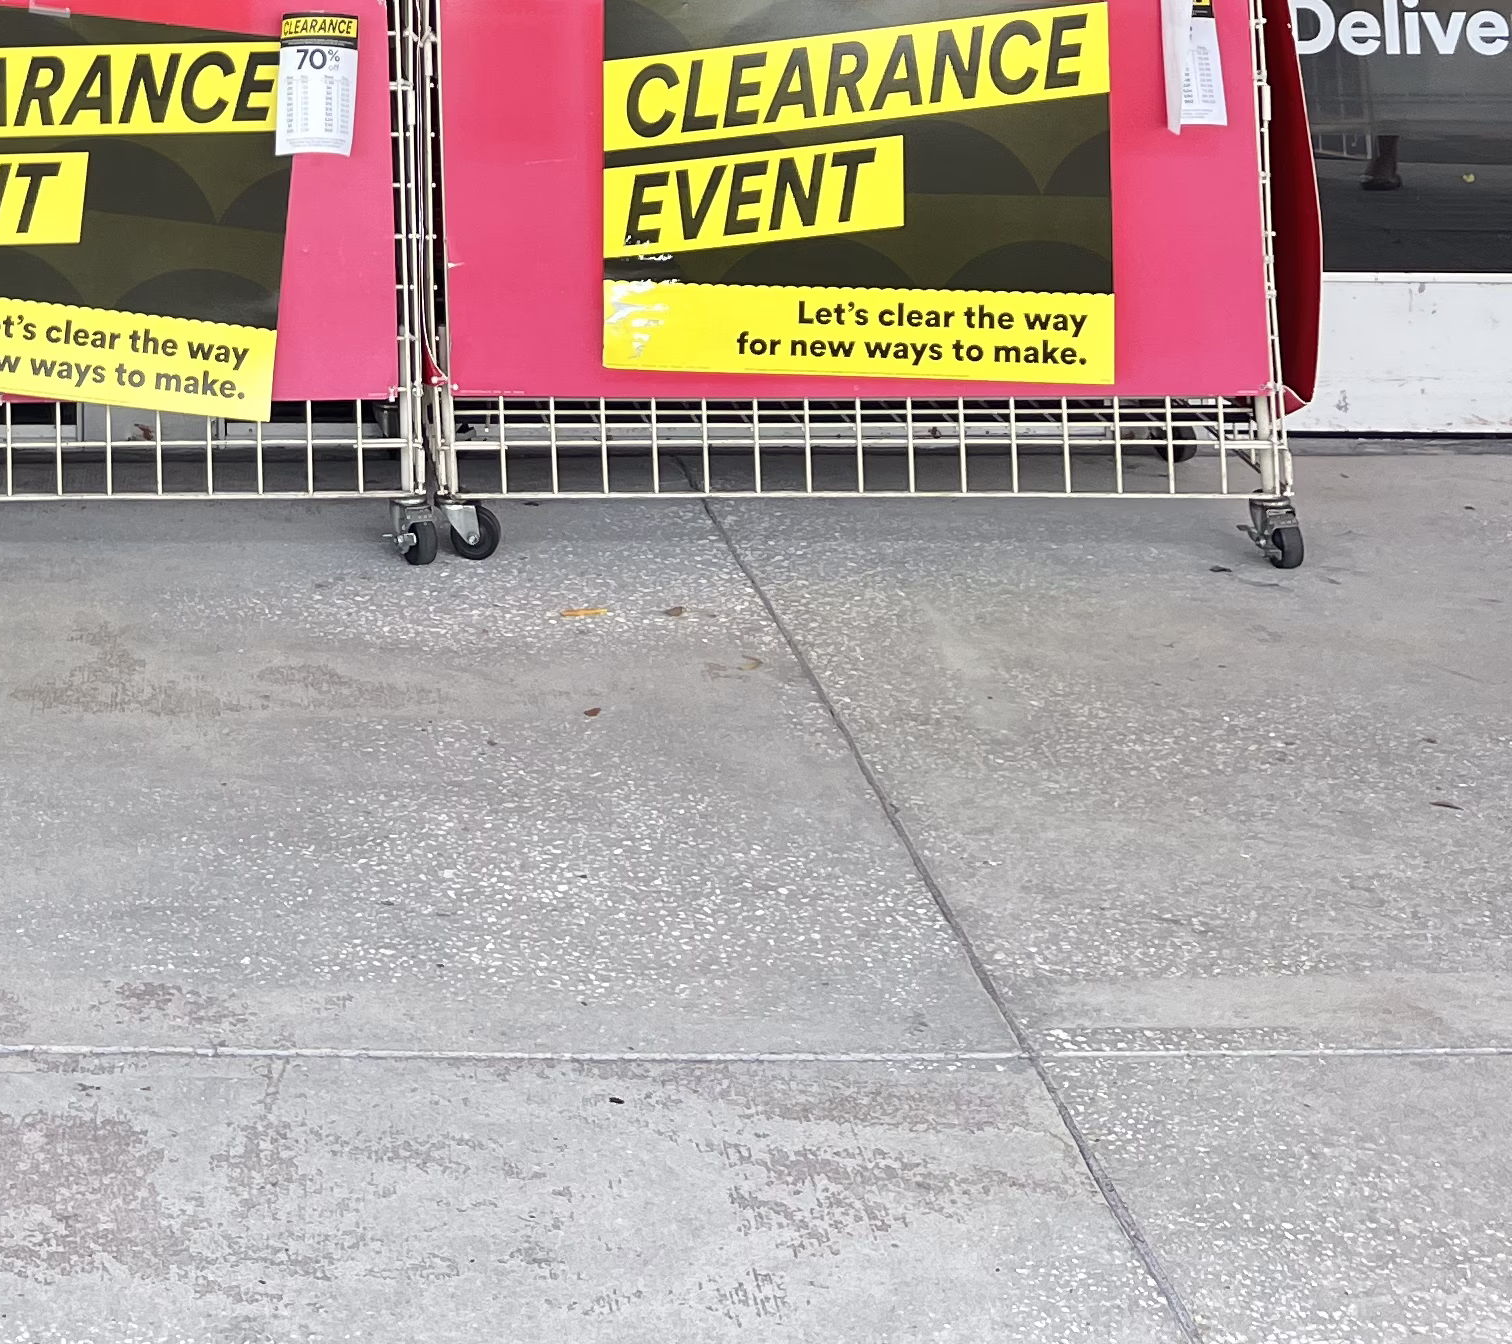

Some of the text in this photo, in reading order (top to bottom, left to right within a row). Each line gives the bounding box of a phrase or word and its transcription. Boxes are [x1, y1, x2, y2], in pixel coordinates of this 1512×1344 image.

[283, 18, 354, 36] CLEARANCE
[625, 13, 1089, 140] CLEARANCE
[623, 146, 878, 247] EVENT
[798, 300, 1088, 338] Let's clear the way
[45, 319, 121, 351] clear
[128, 328, 178, 357] the
[187, 341, 250, 371] way
[736, 330, 1087, 366] for new ways to make.
[30, 358, 106, 388] ways
[114, 363, 145, 388] to
[154, 370, 246, 401] make.
